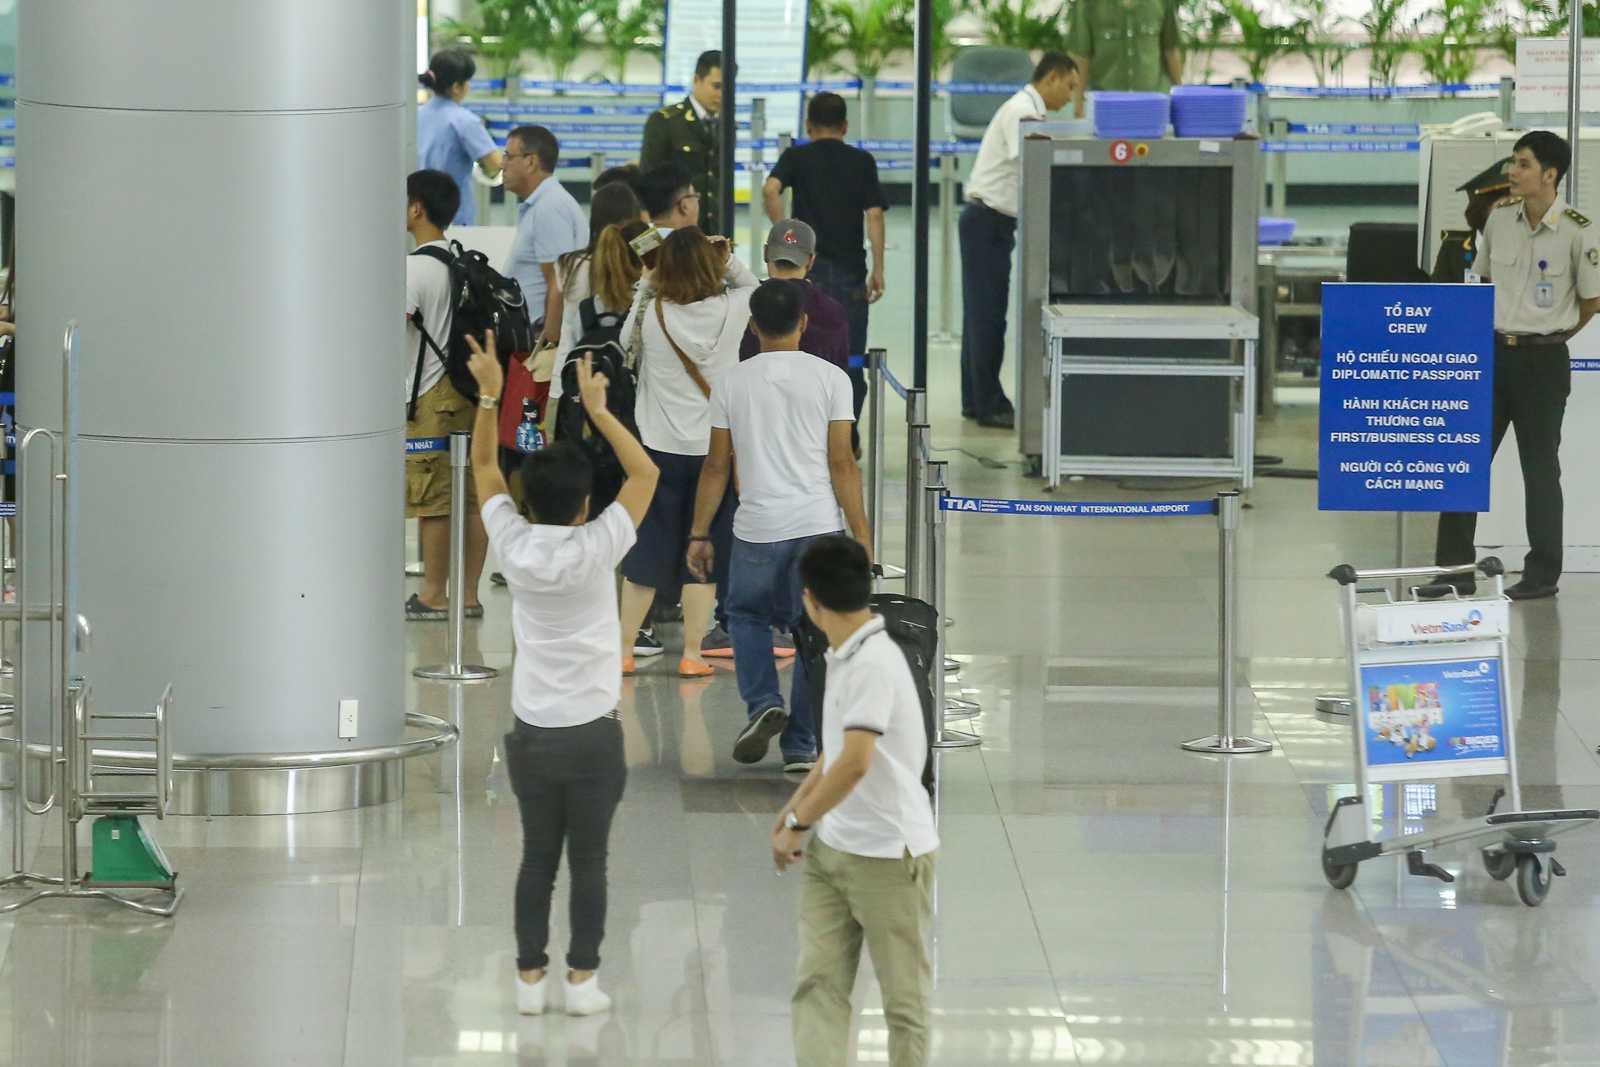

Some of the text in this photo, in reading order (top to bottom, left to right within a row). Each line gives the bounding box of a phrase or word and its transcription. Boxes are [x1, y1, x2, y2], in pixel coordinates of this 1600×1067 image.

[1114, 142, 1128, 161] 6
[1384, 302, 1432, 317] TỔ BAY
[1388, 323, 1428, 334] CREW
[1336, 349, 1478, 366] HỘ CHIẾU NGOẠI GIAO
[1331, 369, 1482, 381] DIPLOMATIC PASSPORT
[1343, 397, 1469, 412] HÀNH KHÁCH HẠNG
[1365, 415, 1446, 427] THƯƠNG GIA
[1330, 432, 1481, 444] FIRST/BUSINESS CLASS
[1340, 460, 1470, 473] NGƯỜI CÓ CÔNG VỚI
[1364, 477, 1444, 491] CÁCH MẠNG
[943, 498, 978, 511] TIA
[1015, 503, 1189, 513] TAN SON NHAT INTERNATIONAL AIRPORT
